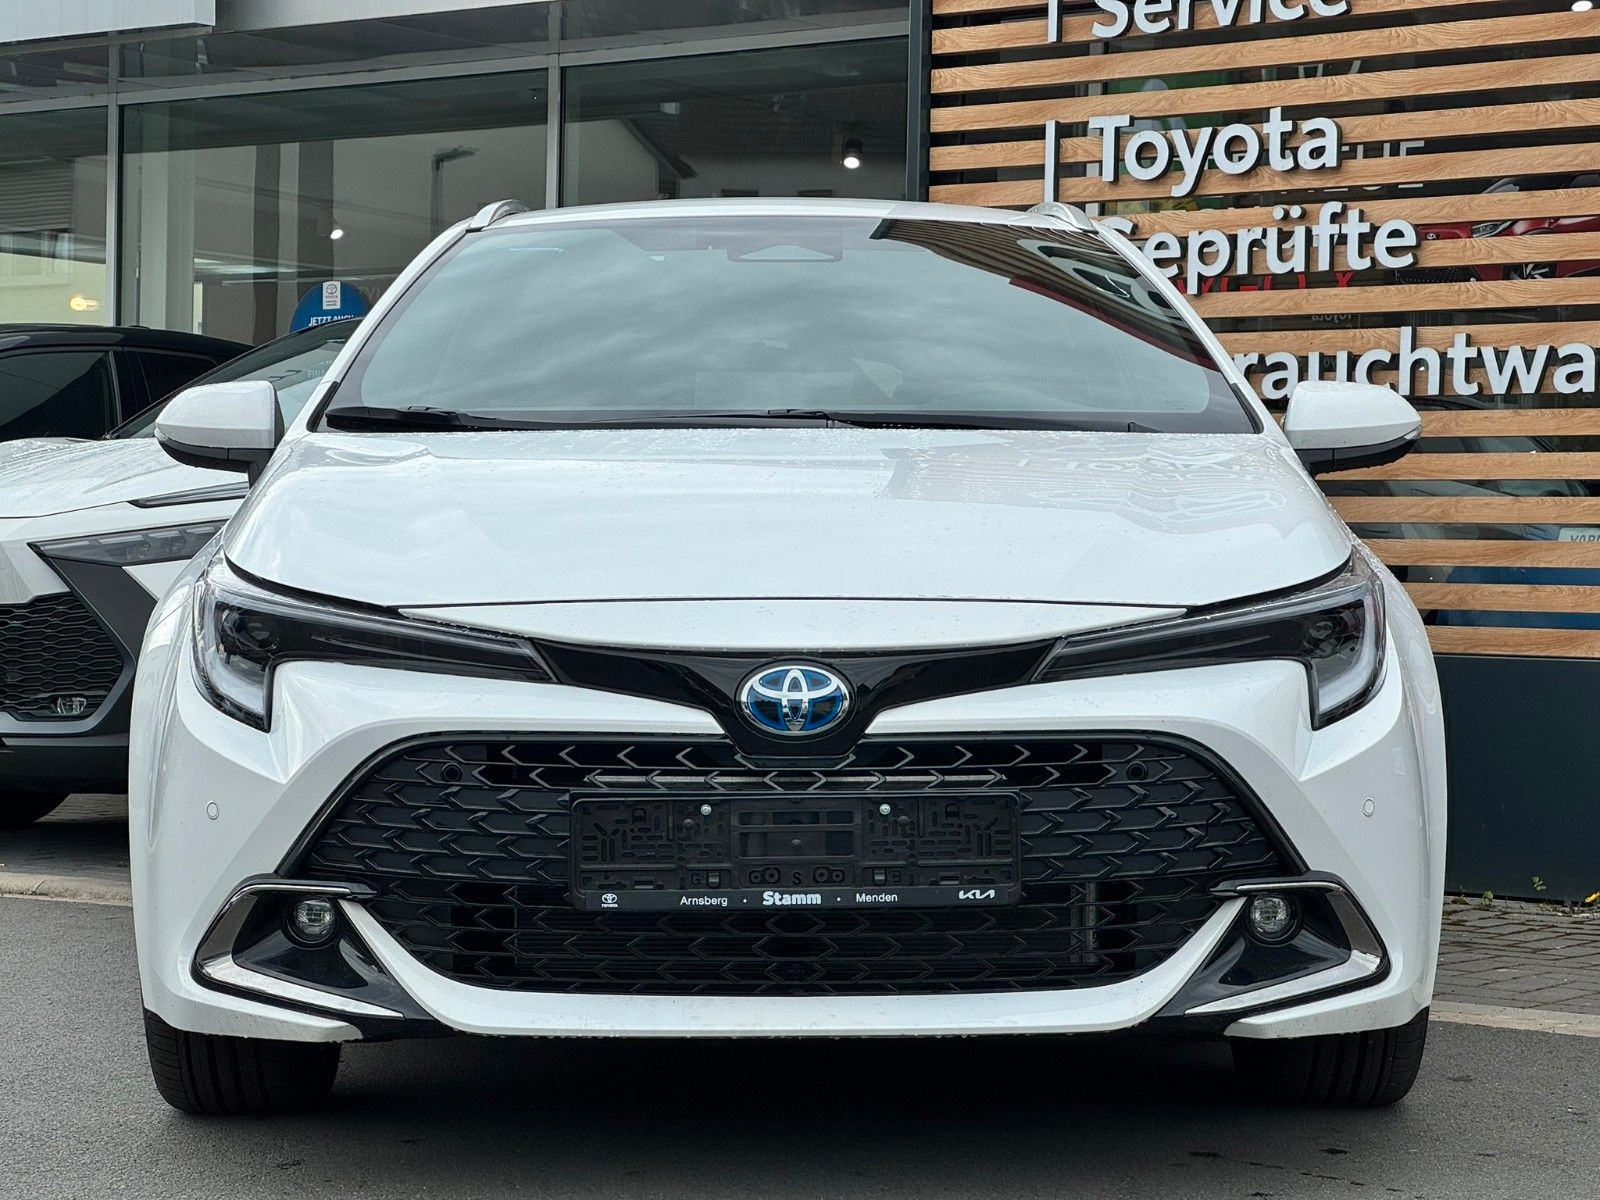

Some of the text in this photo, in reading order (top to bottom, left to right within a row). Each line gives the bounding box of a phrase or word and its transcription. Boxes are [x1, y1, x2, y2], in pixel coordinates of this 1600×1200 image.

[1088, 107, 1339, 197] Toyota
[1102, 201, 1418, 294] eprüfte
[680, 891, 898, 907] Arnsberg Stamm Menden
